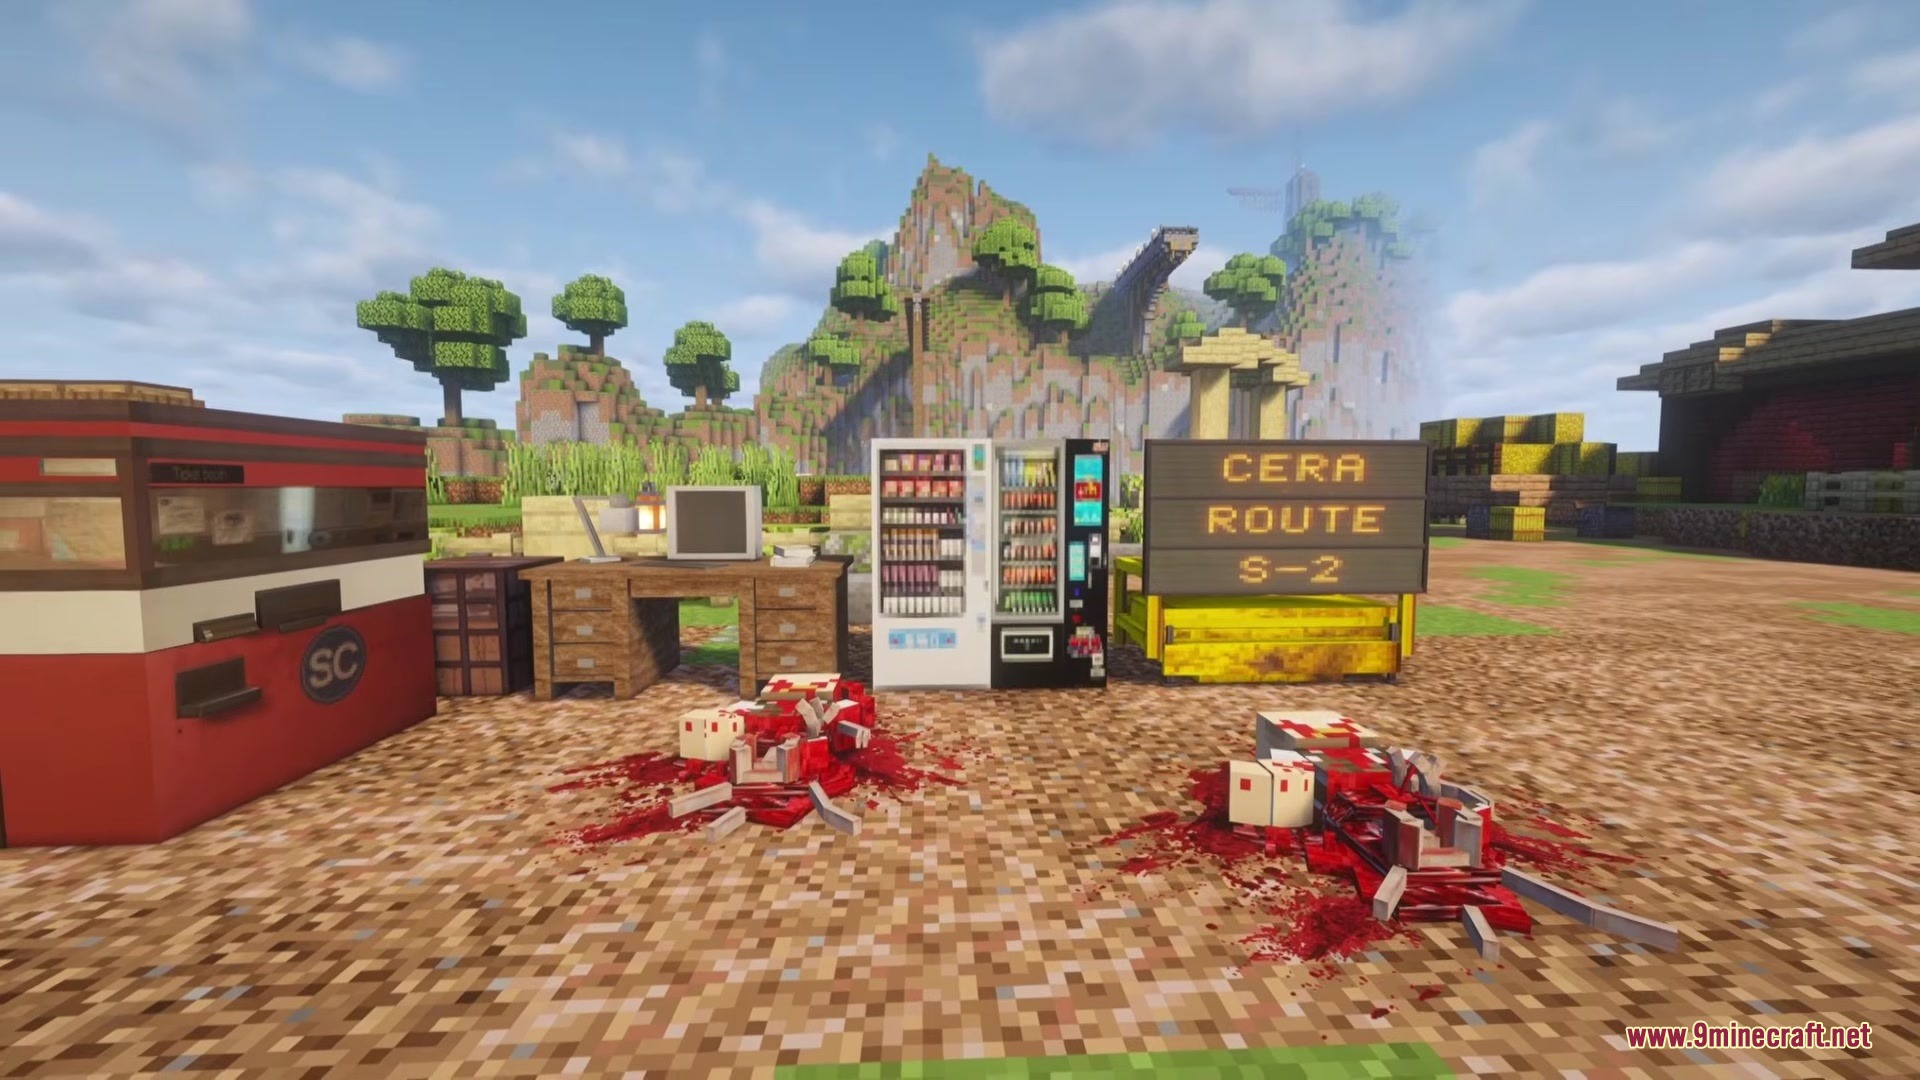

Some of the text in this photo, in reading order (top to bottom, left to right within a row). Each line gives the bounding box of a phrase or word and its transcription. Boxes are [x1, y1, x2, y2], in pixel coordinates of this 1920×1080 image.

[1223, 453, 1365, 482] CERA
[1207, 506, 1386, 534] ROUTE
[1239, 555, 1343, 583] S-2
[310, 641, 358, 689] SC
